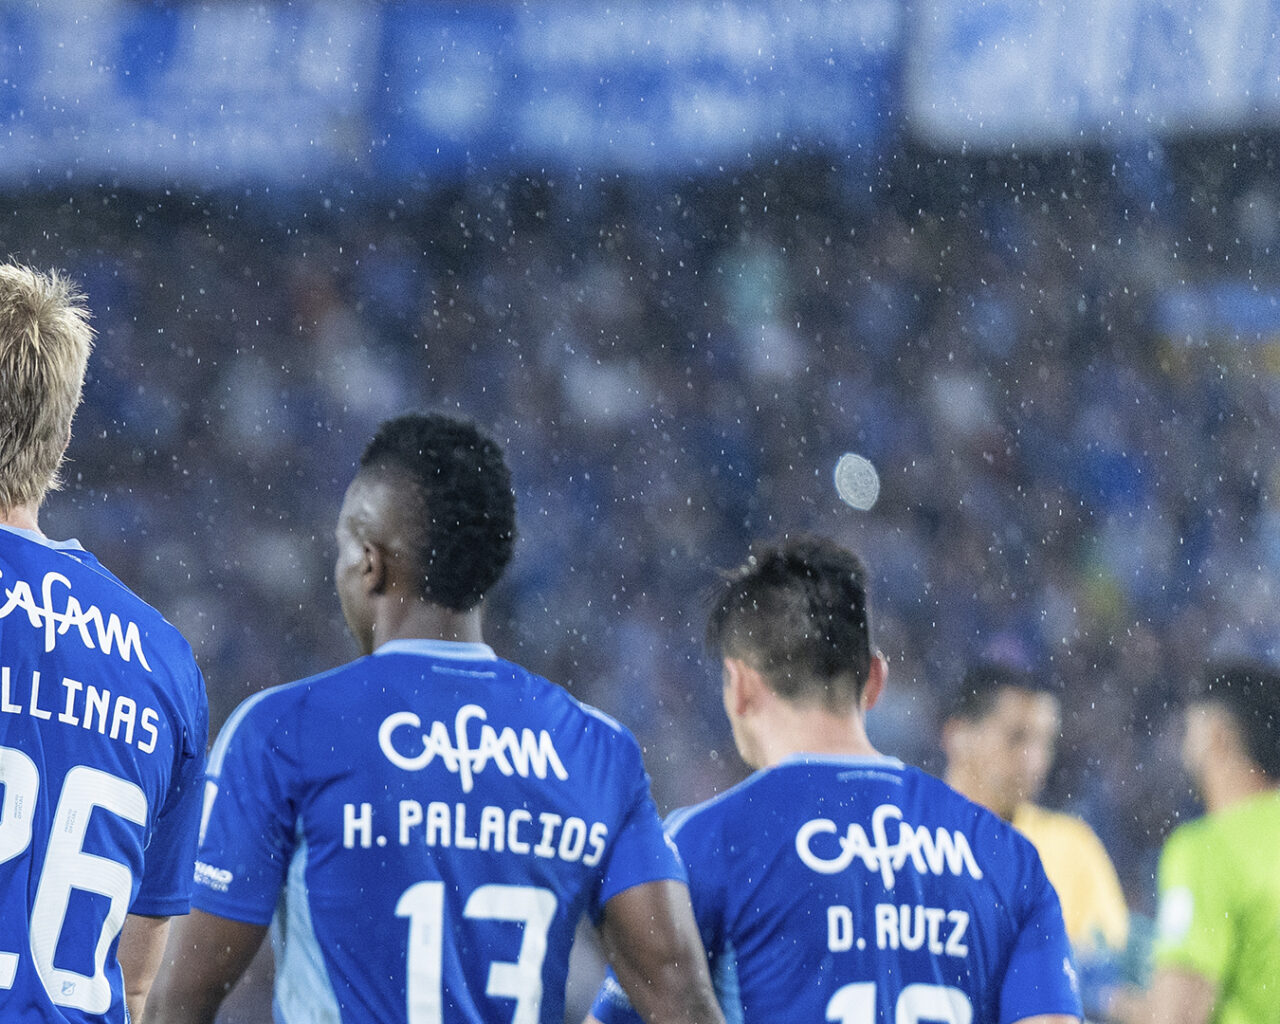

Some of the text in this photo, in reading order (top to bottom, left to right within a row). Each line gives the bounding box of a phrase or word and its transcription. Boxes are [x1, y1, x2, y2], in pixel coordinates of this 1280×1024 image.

[1, 666, 159, 754] LLINAS
[343, 799, 608, 866] H. PALACIOS
[827, 905, 866, 952] D.
